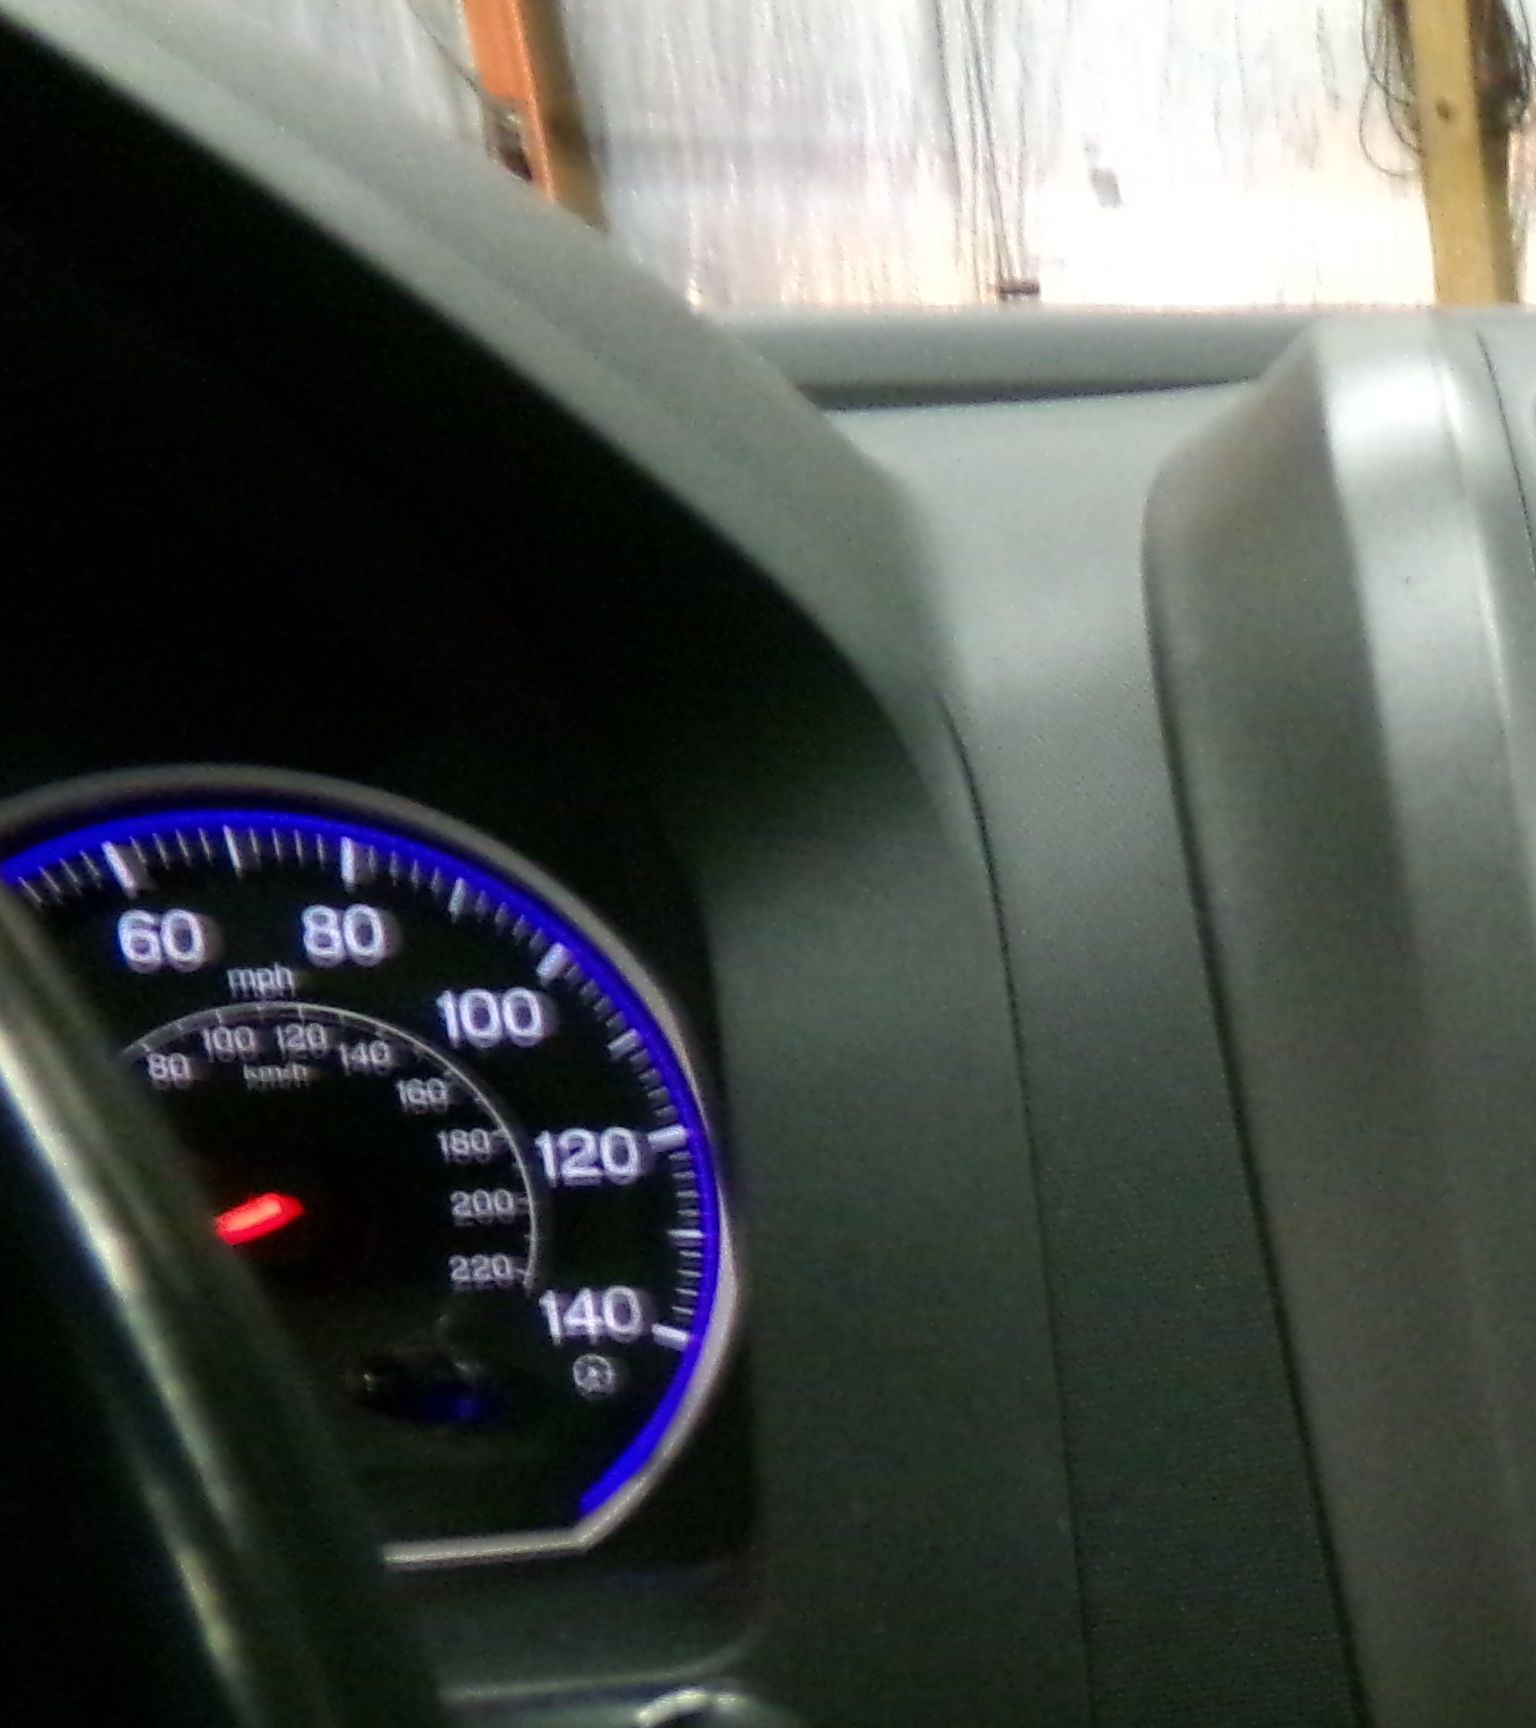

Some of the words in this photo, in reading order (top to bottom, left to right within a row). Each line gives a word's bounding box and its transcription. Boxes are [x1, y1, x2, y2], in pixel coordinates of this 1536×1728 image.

[117, 908, 207, 970] 60
[301, 905, 388, 965] 80
[227, 964, 296, 998] mph
[436, 987, 546, 1047] 100
[203, 1025, 259, 1061] 100
[274, 1023, 328, 1059] 120
[339, 1041, 391, 1076] 140
[148, 1053, 194, 1090] 80
[396, 1079, 447, 1114] 160
[437, 1130, 492, 1163] 180
[536, 1128, 642, 1187] 120
[451, 1190, 516, 1224] 200
[449, 1256, 514, 1288] 220
[541, 1286, 646, 1345] 140
